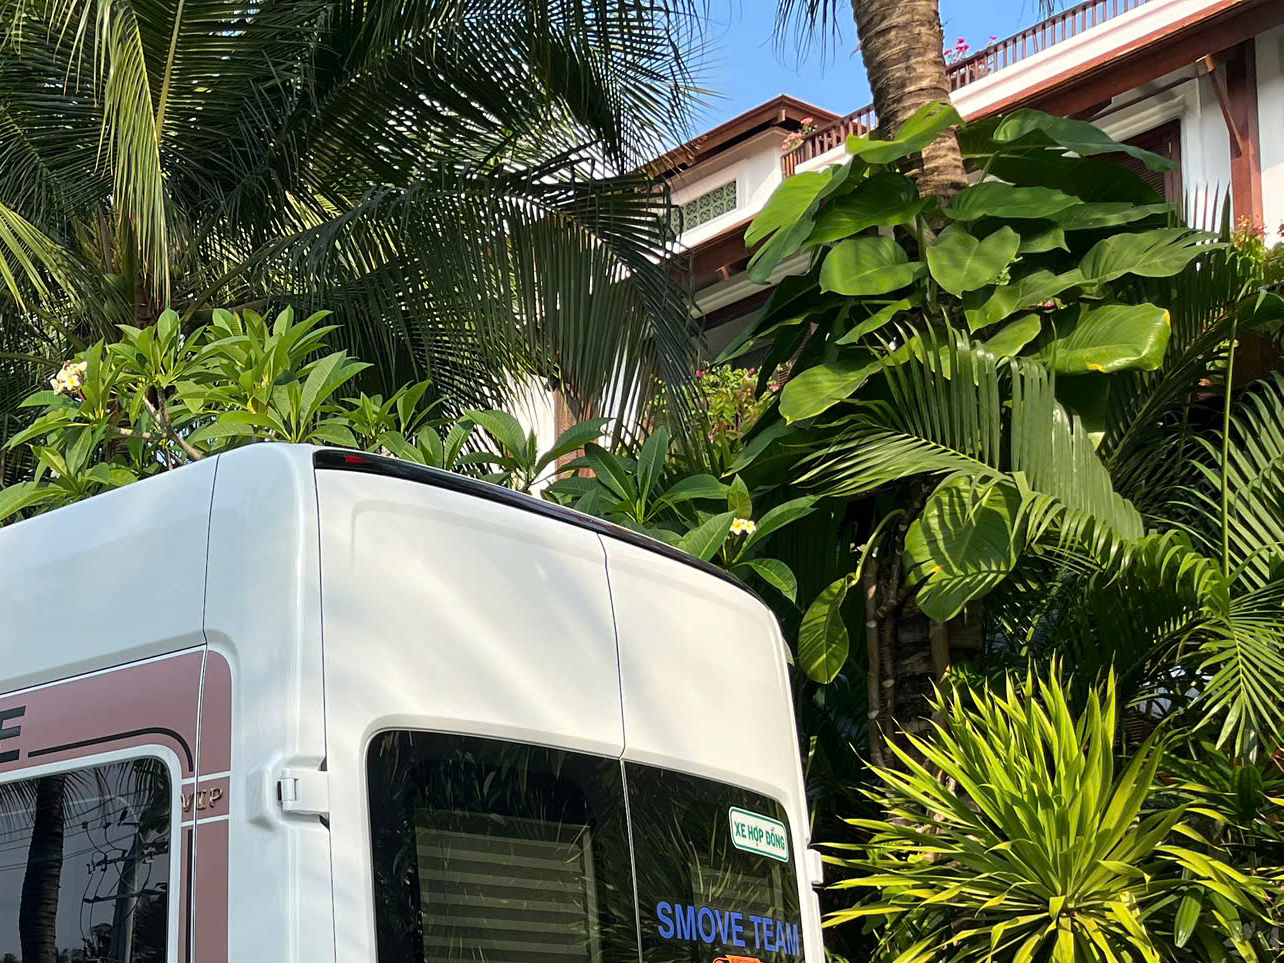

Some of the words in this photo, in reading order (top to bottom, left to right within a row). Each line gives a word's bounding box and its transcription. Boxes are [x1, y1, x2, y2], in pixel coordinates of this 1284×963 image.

[734, 821, 747, 839] XE
[747, 824, 764, 847] HỢP
[656, 901, 746, 948] SMOVE
[749, 915, 801, 957] TEAM
